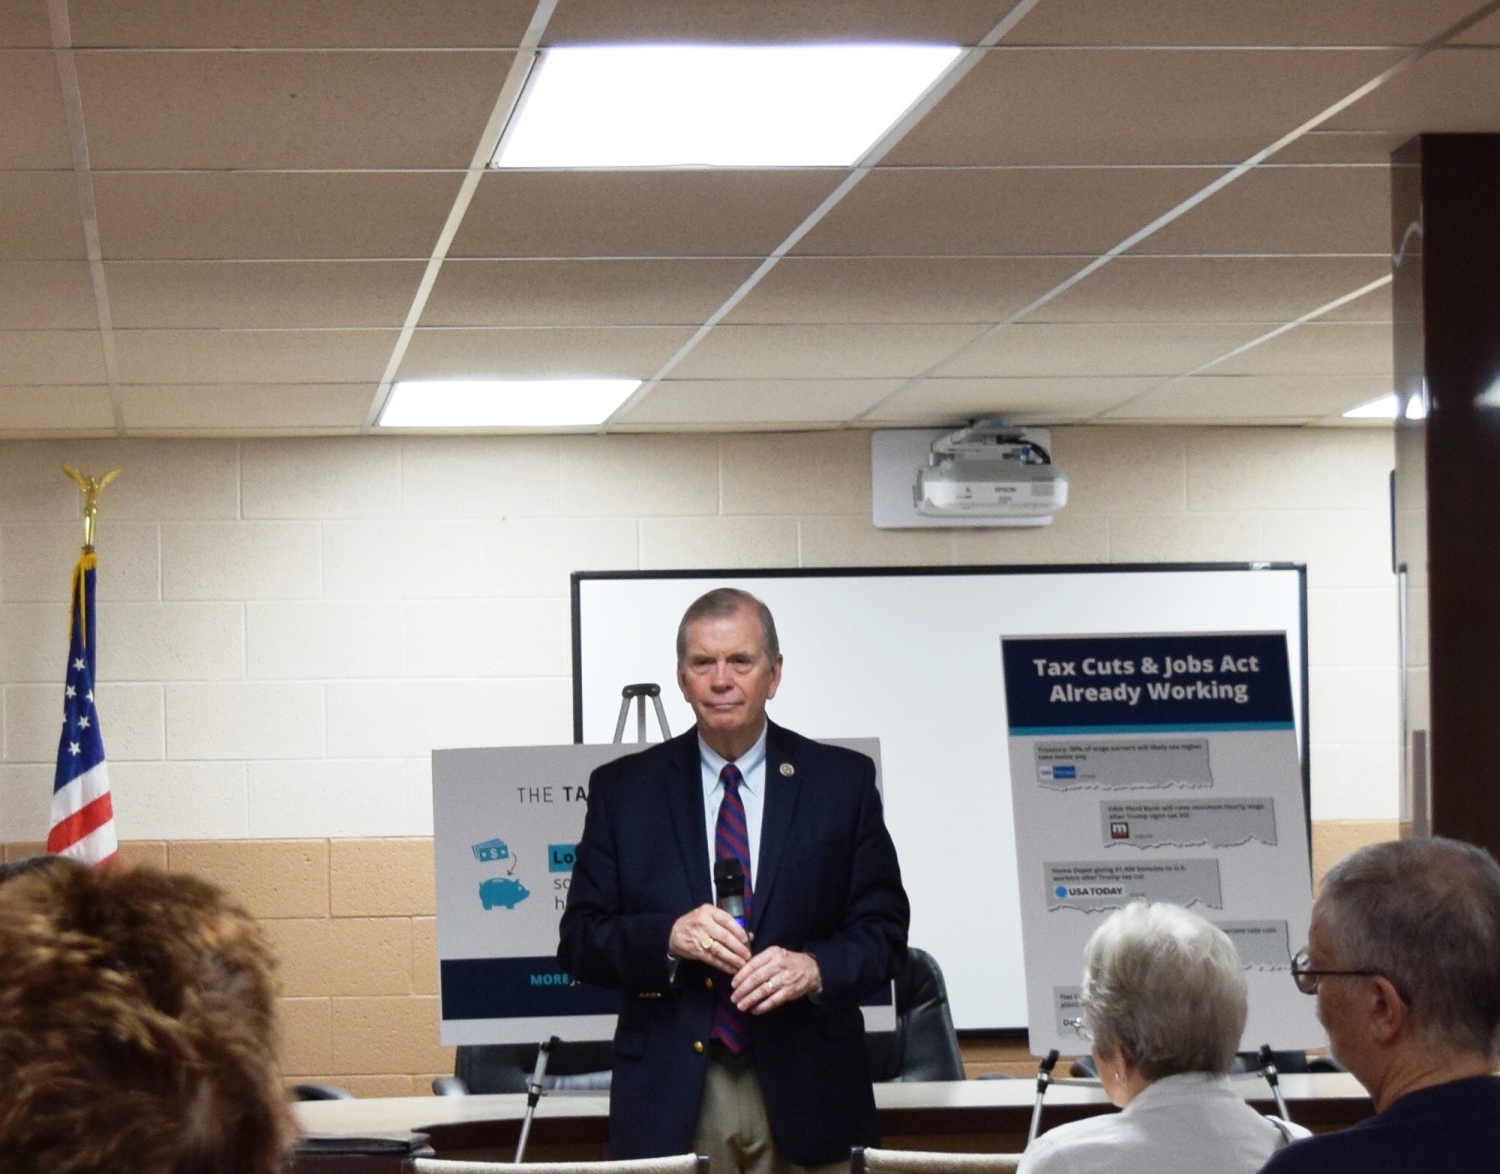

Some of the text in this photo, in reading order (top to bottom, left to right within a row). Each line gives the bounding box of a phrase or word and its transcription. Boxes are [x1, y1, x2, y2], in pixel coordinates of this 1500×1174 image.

[1033, 654, 1260, 679] Tax Cuts & Jobs Act
[1049, 680, 1248, 706] Already Working
[517, 785, 588, 803] THE TA
[553, 851, 575, 865] Lo
[1069, 887, 1090, 896] USA
[1090, 886, 1122, 896] TODAY
[530, 973, 570, 986] MORE
